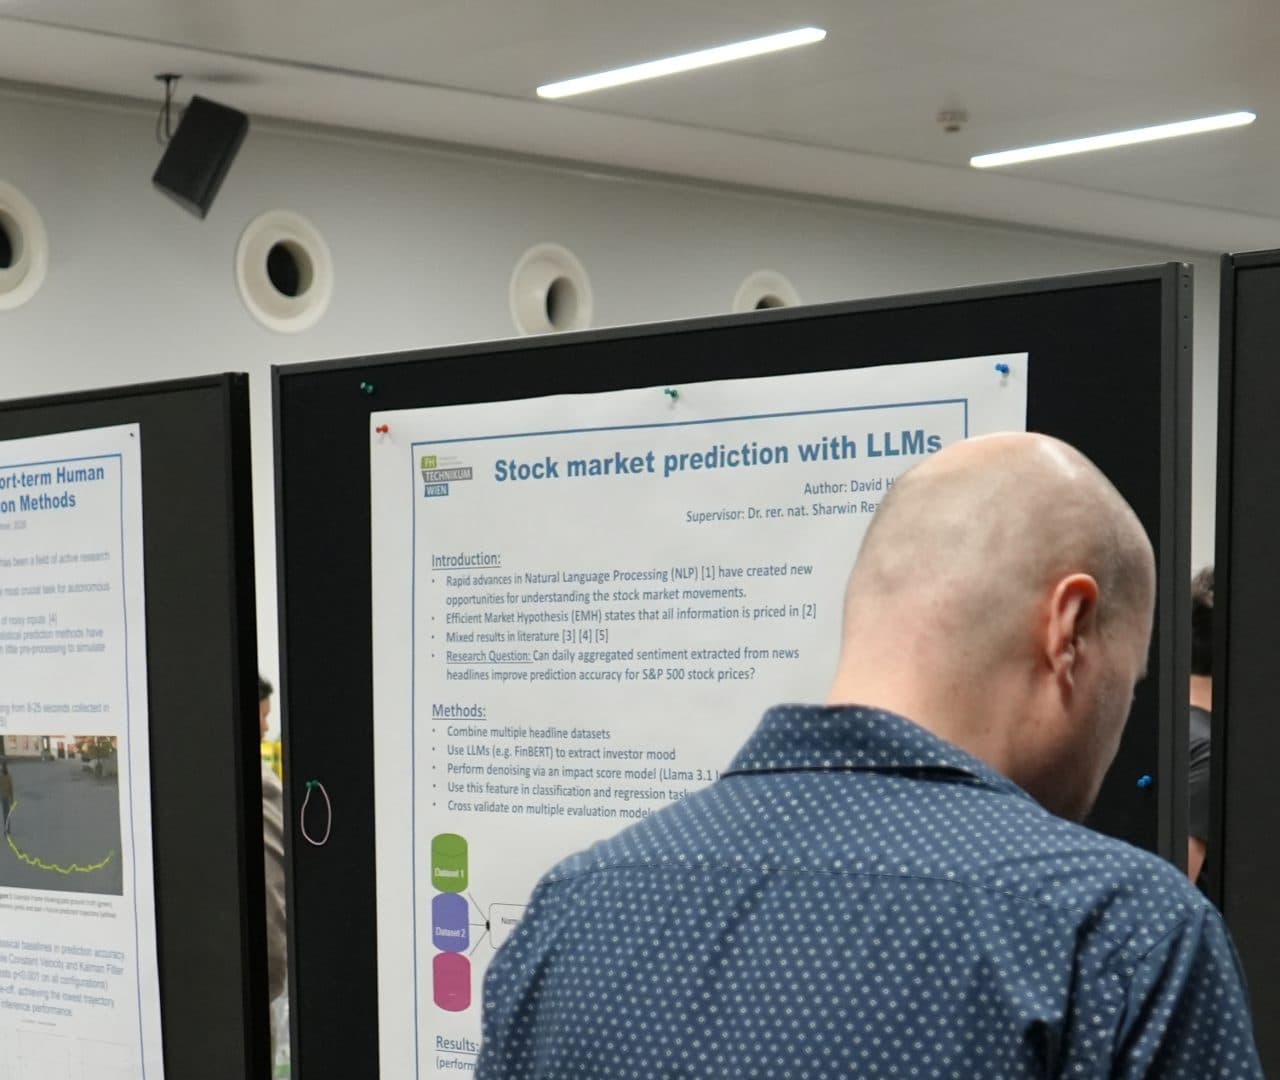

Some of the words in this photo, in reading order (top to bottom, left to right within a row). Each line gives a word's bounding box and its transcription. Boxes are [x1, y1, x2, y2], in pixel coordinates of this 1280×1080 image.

[494, 456, 559, 482] Stock
[567, 450, 655, 477] market
[663, 441, 788, 478] prediction
[797, 434, 856, 462] with
[867, 429, 942, 458] LLMs
[56, 466, 104, 484] Human
[803, 481, 847, 495] Author:
[850, 477, 882, 492] David
[19, 490, 76, 512] Methods
[685, 508, 744, 524] Supervisor:
[747, 506, 762, 519] Dr.
[765, 508, 784, 518] rer.
[786, 504, 809, 517] nat.
[812, 501, 857, 516] Sharwin
[431, 551, 501, 567] Introduction:
[445, 631, 474, 643] Mixed
[476, 631, 505, 643] results
[507, 630, 515, 642] in
[516, 630, 559, 642] literature
[561, 628, 575, 644] [3]
[578, 628, 592, 644] [4]
[595, 628, 608, 644] [5]
[432, 703, 486, 718] Methods:
[447, 725, 488, 737] Combine
[489, 725, 527, 740] multiple
[528, 726, 568, 739] headline
[570, 727, 611, 740] datasets
[447, 744, 464, 756] Use
[466, 744, 490, 756] LLMs
[492, 744, 512, 759] (e.g.
[514, 745, 553, 760] FinBERT)
[555, 747, 566, 758] to
[567, 747, 601, 759] extract
[602, 747, 644, 760] investor
[646, 747, 676, 761] mood
[435, 1035, 480, 1056] Results:
